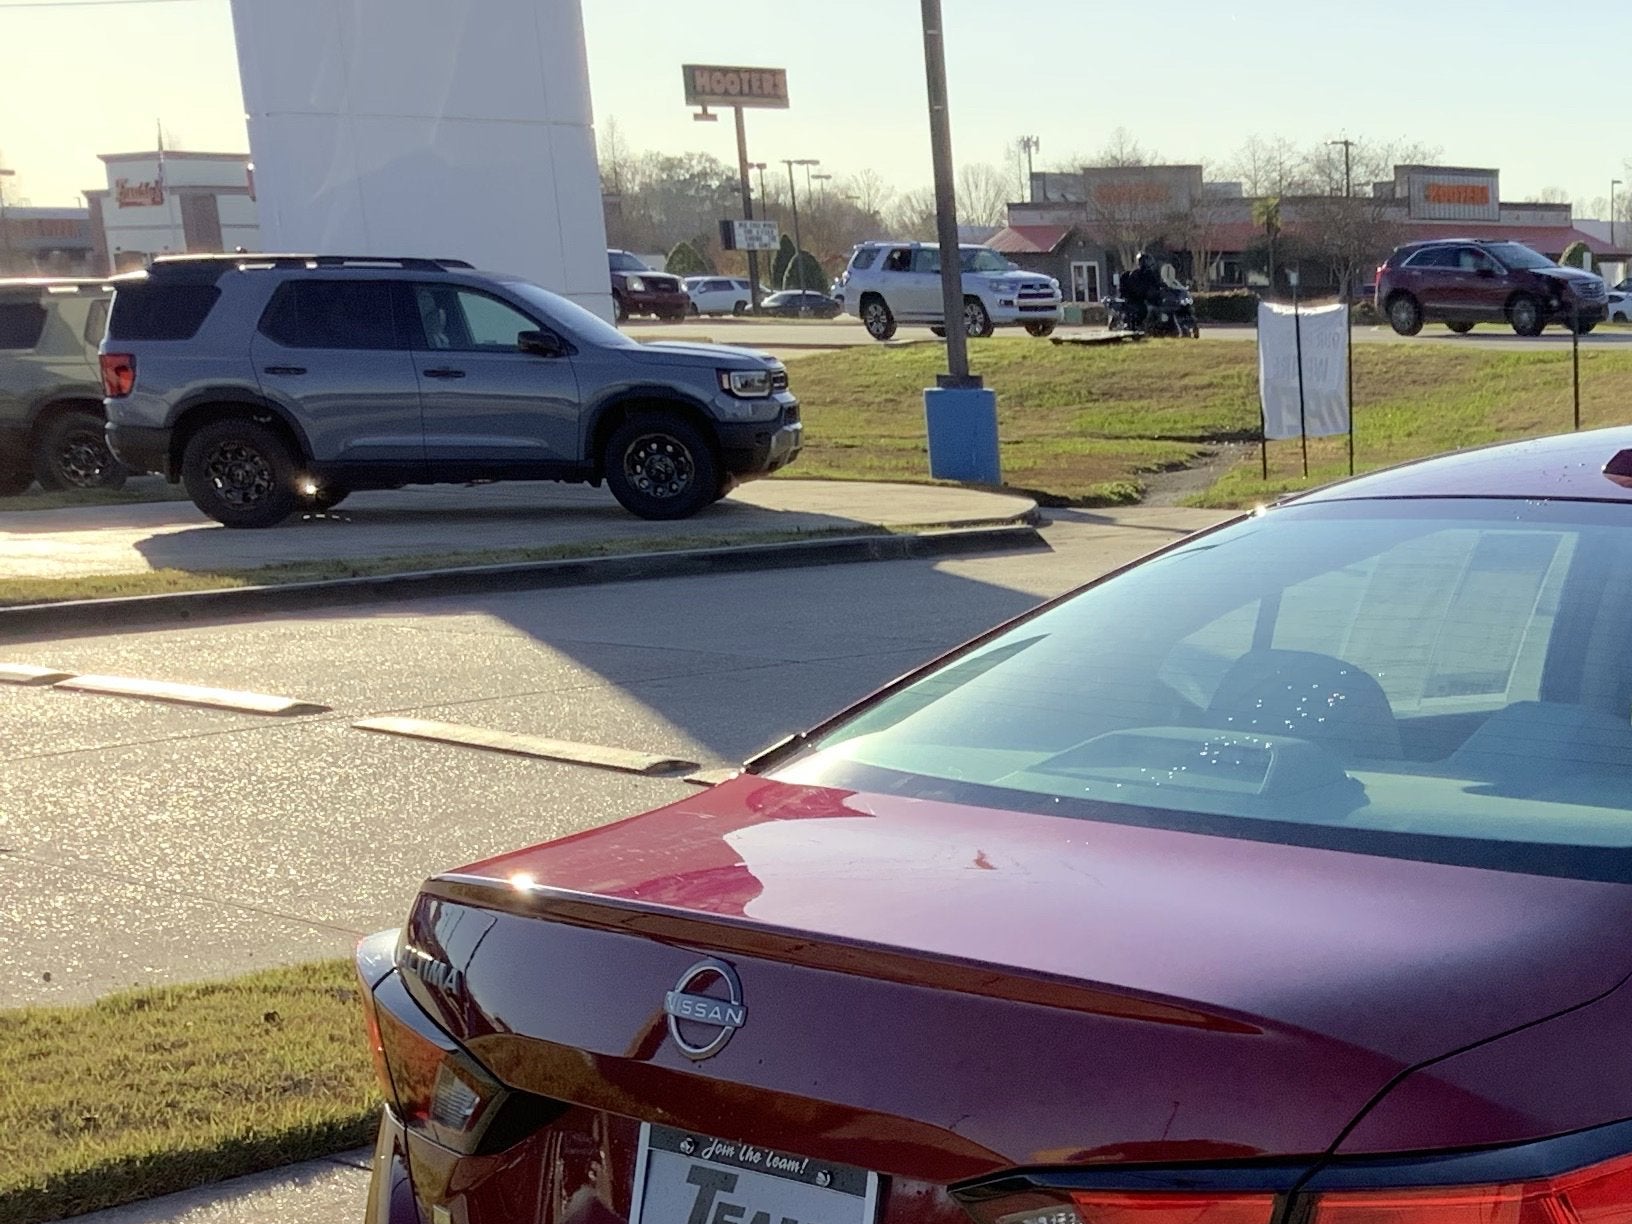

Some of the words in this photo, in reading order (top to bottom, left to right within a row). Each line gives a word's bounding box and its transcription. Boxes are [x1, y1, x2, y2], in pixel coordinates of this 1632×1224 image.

[694, 70, 786, 98] HOOTERS
[665, 990, 744, 1027] NISSAN
[701, 1137, 736, 1160] Join
